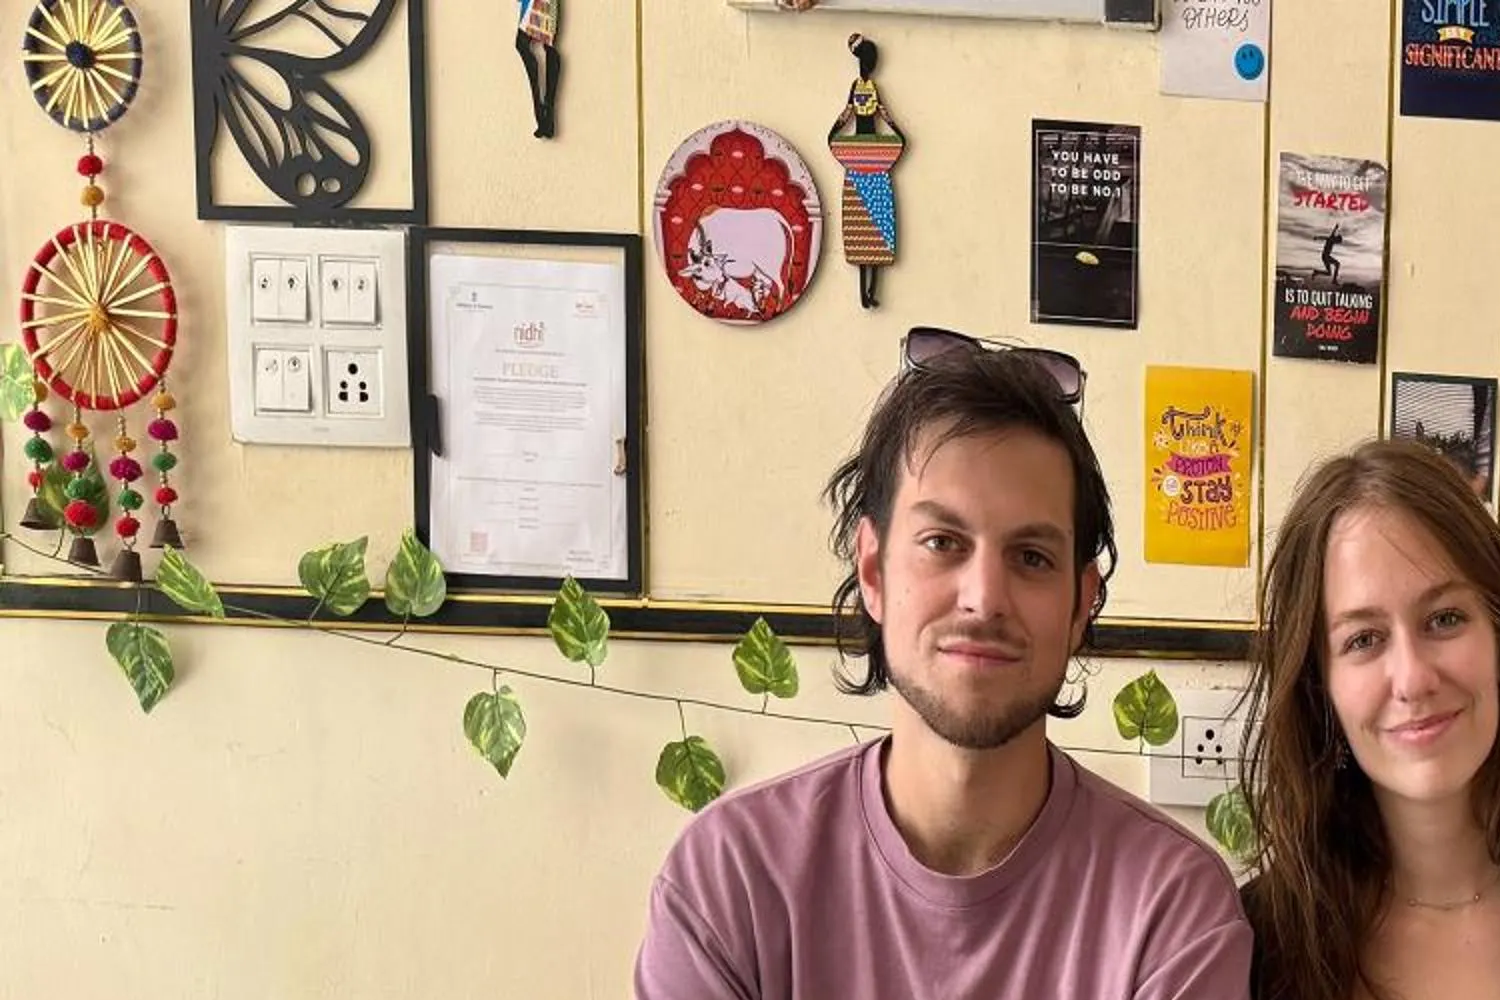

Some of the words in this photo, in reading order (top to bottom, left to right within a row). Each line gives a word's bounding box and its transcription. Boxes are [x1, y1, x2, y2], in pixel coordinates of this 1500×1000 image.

[1053, 151, 1079, 162] YOU
[1083, 152, 1119, 165] HAVE
[1051, 167, 1067, 178] TO
[1071, 167, 1088, 179] BE
[1093, 169, 1120, 181] ODD
[1050, 184, 1067, 195] TO
[1071, 184, 1087, 195] BE
[1292, 190, 1369, 212] STARTED
[1285, 288, 1295, 303] IS
[1296, 289, 1309, 304] TO
[1311, 291, 1333, 307] QUIT
[1335, 292, 1373, 309] TALKING
[1290, 306, 1319, 321] AND
[1323, 308, 1370, 324] BEGIN
[1306, 323, 1353, 341] DOING
[502, 362, 559, 379] PLEDGE
